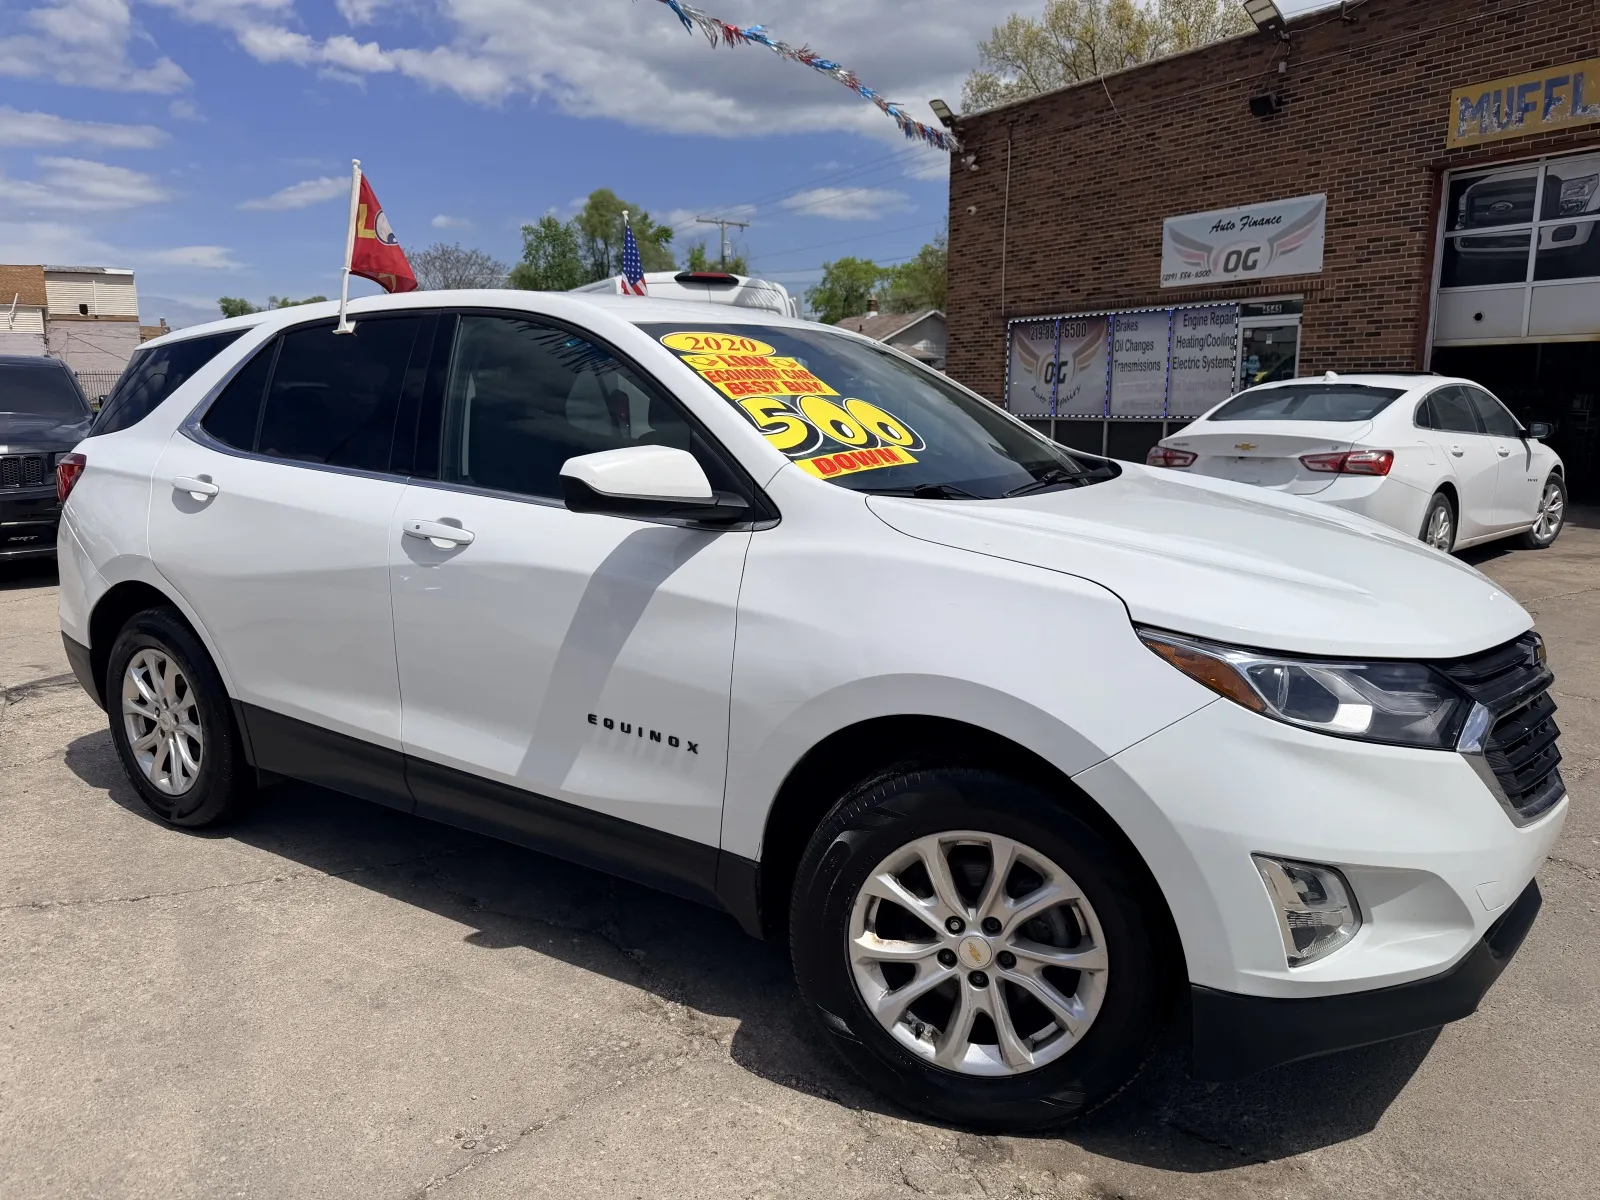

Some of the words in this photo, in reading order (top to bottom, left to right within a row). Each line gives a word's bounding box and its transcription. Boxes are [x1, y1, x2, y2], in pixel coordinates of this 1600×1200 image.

[1209, 219, 1235, 234] Auto
[1240, 215, 1282, 231] Finance
[1222, 246, 1262, 273] OG
[1115, 319, 1138, 332] Brakes
[1183, 313, 1208, 330] Engine
[1210, 311, 1235, 328] Repair
[1030, 322, 1087, 341] 219-88-6500
[684, 336, 757, 352] 2020
[1115, 340, 1123, 352] Oil
[1125, 339, 1154, 354] Changes
[1176, 333, 1235, 351] Heating/Cooling
[716, 355, 775, 368] LOOK
[1114, 359, 1161, 372] Transmissions
[1172, 356, 1199, 370] Electric
[1202, 355, 1234, 372] Systems
[704, 368, 781, 383] ECONOMY
[782, 368, 815, 381] CAR
[1043, 360, 1068, 384] OG
[724, 381, 780, 396] BEST
[783, 380, 827, 394] BUY
[735, 395, 927, 457] 500
[811, 448, 904, 476] DOWN
[587, 713, 698, 755] EQUINOX
